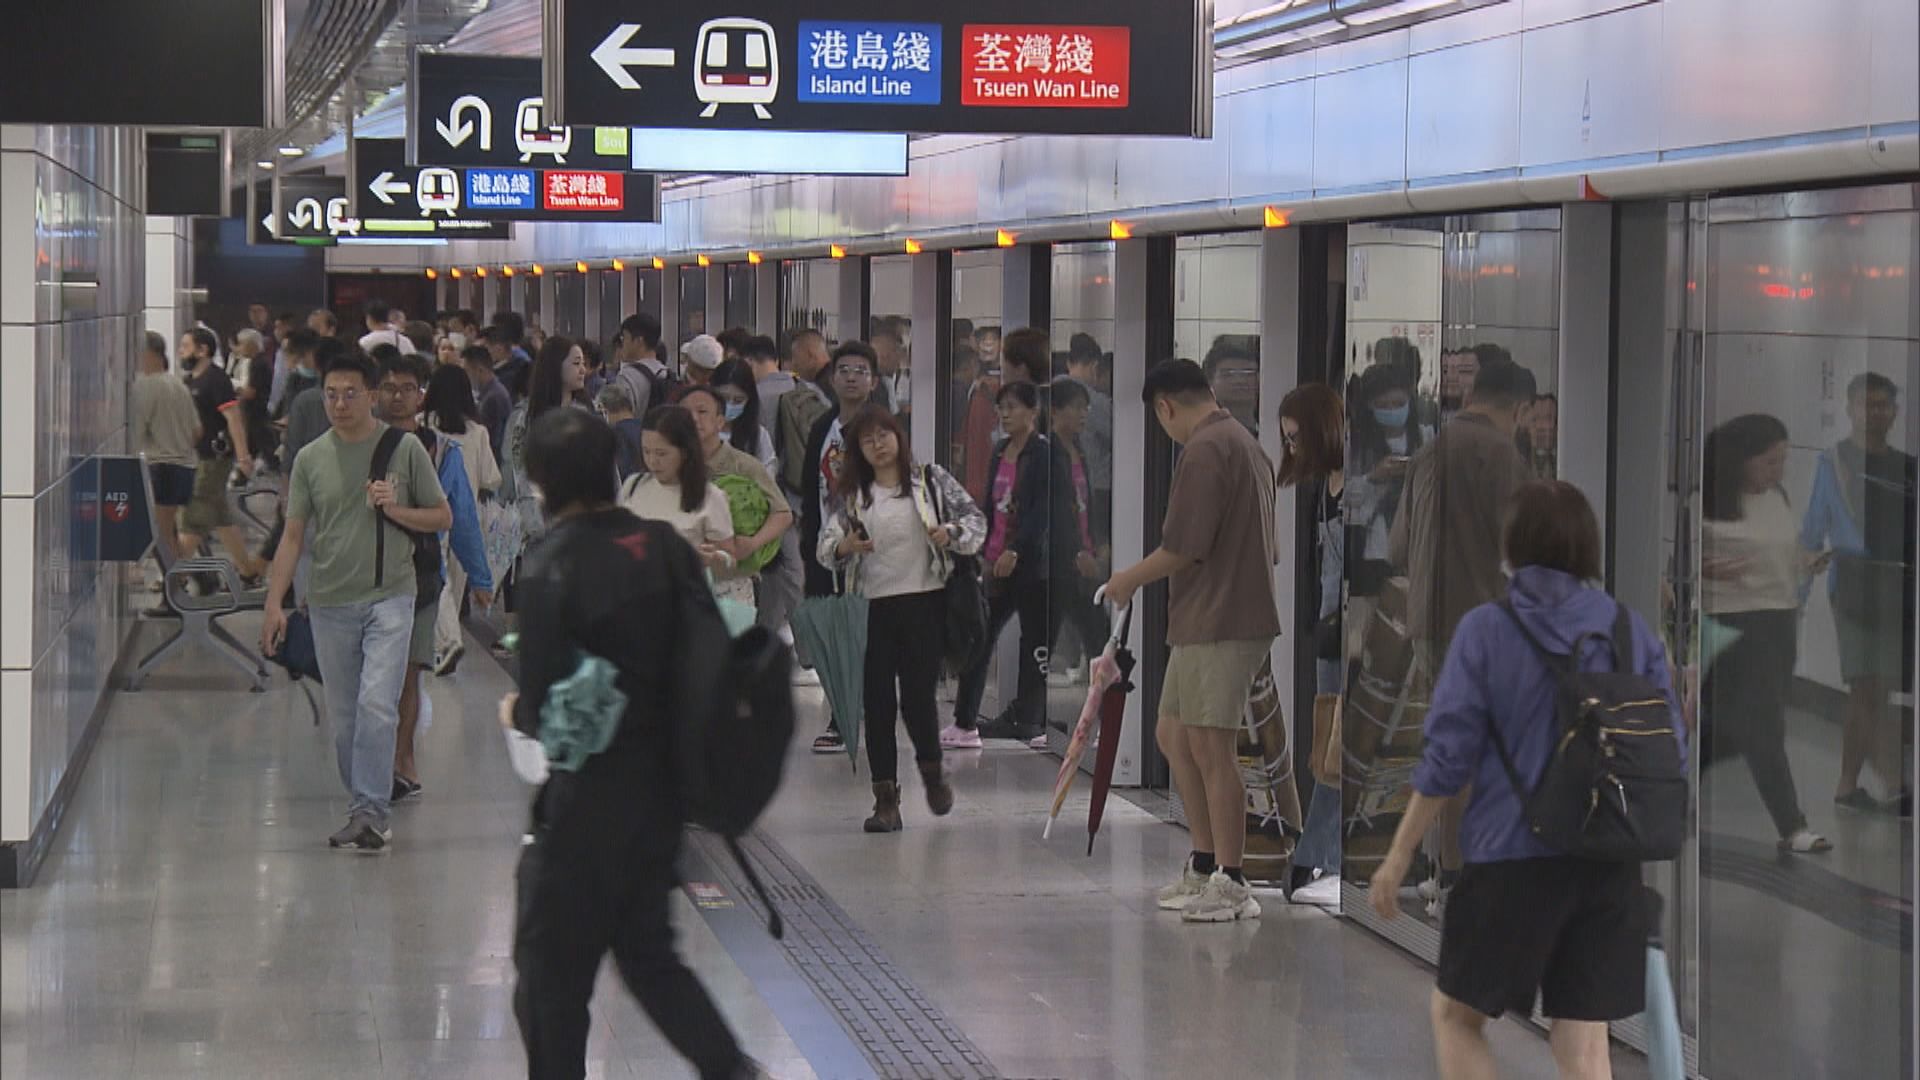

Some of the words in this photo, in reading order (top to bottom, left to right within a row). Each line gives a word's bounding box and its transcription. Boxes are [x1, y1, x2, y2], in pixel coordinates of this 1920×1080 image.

[809, 30, 931, 72] 港島綫
[973, 32, 1094, 74] 荃灣綫
[811, 75, 867, 95] Island
[872, 76, 912, 96] Line
[973, 78, 1028, 98] Tsuen
[1032, 79, 1075, 98] Wan
[1080, 80, 1119, 99] Line
[473, 194, 500, 205] Island
[501, 195, 522, 205] Line
[549, 196, 576, 206] Tsuen
[577, 196, 598, 206] Wan
[600, 197, 619, 206] Line
[105, 492, 129, 502] AED
